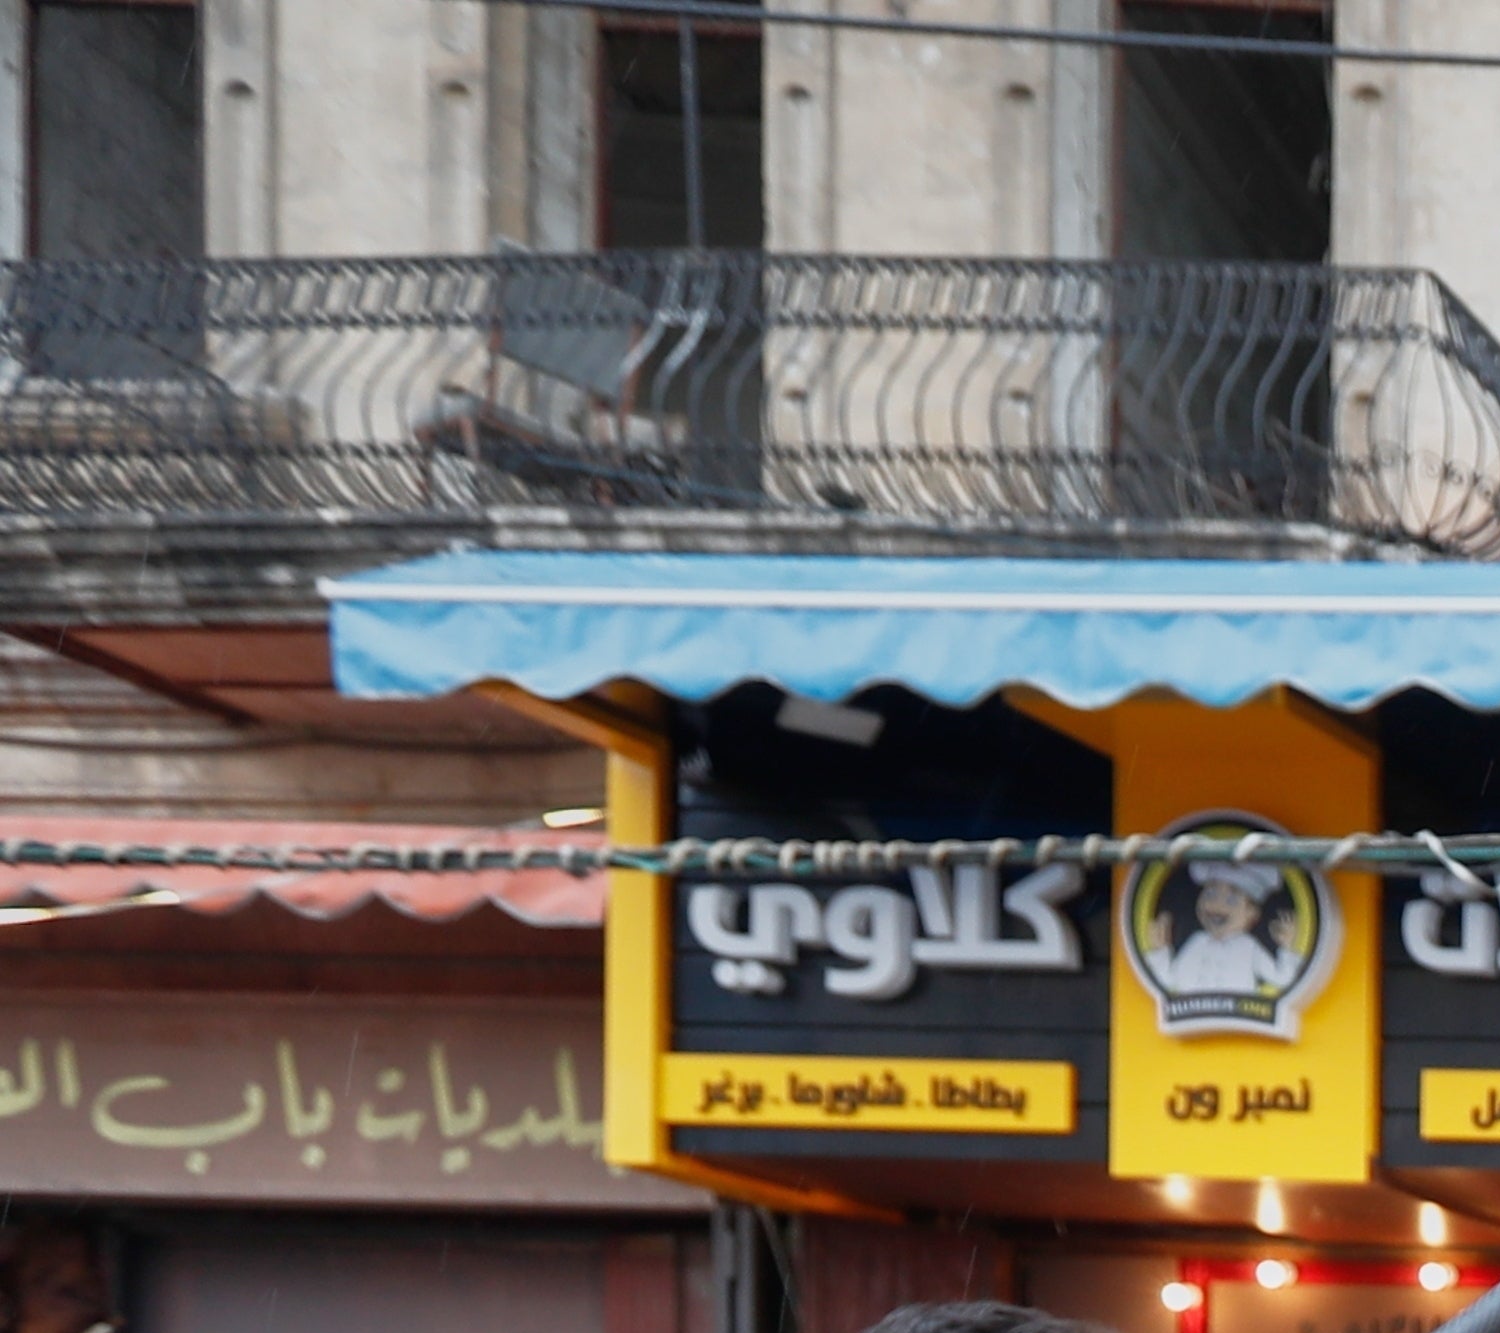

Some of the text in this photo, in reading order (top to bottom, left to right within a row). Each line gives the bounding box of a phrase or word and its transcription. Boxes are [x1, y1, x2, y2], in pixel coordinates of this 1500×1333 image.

[686, 862, 1084, 998] كلاوي
[92, 1039, 335, 1177] باب
[355, 1041, 630, 1177] لديات
[788, 1070, 906, 1116] شاورما
[930, 1075, 1026, 1118] بطاطا
[1165, 1076, 1312, 1123] نمبر ون
